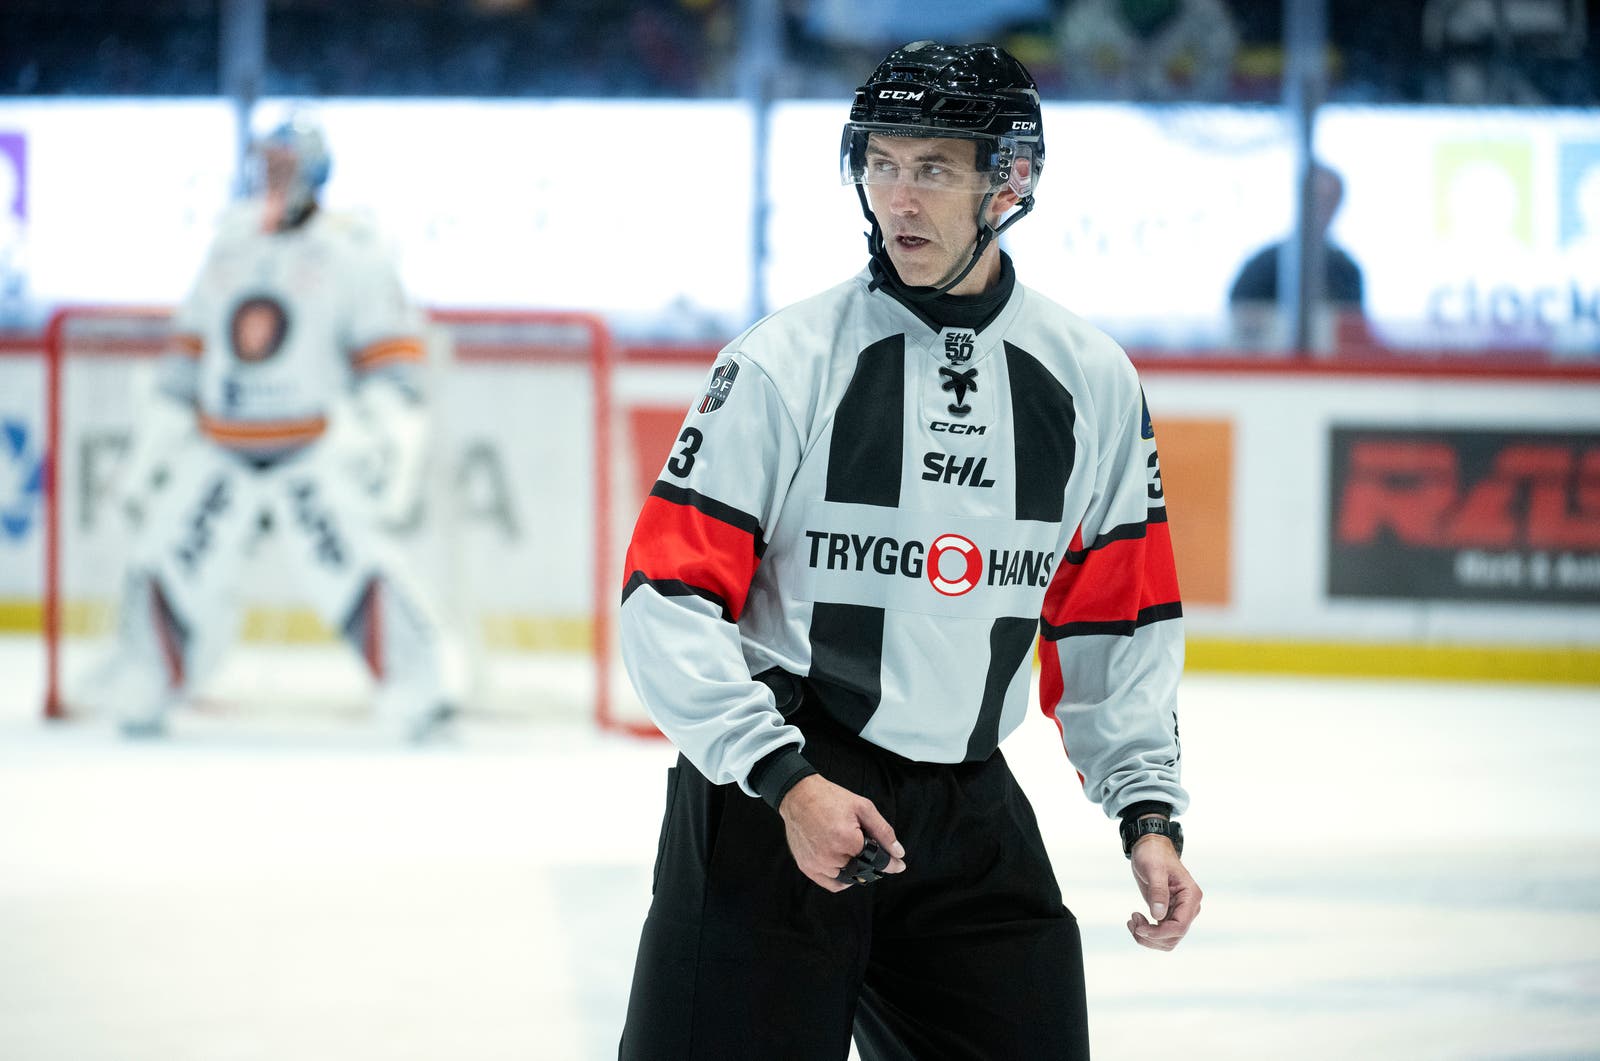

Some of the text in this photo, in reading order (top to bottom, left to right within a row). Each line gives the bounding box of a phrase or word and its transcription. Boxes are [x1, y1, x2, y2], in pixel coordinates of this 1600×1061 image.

[878, 90, 924, 101] CCM
[1011, 121, 1036, 131] CCM
[945, 332, 975, 343] SHL
[945, 342, 974, 361] 50
[929, 421, 987, 435] CCM
[667, 426, 703, 479] 3
[921, 451, 996, 488] SHL
[805, 530, 1055, 588] TRYGG HANS
